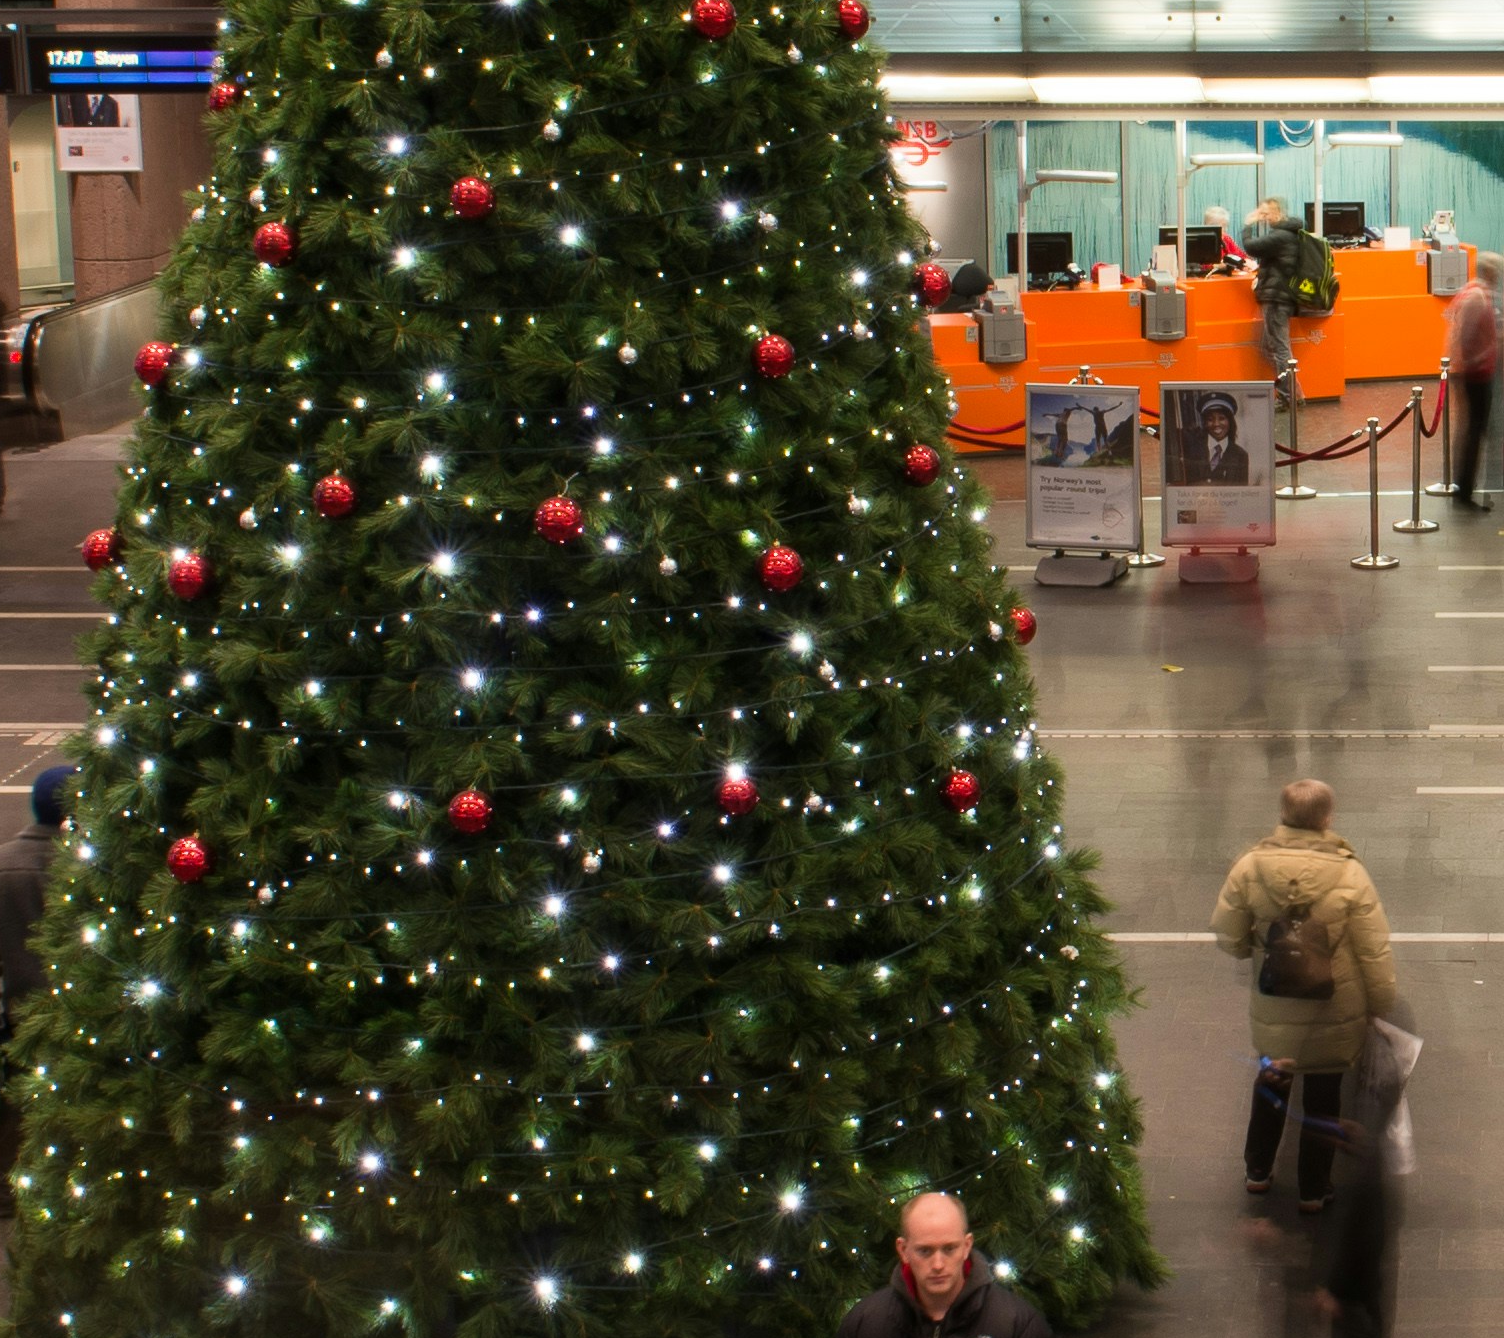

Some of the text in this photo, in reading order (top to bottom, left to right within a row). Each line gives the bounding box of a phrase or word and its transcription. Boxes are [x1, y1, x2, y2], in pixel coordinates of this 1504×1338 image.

[897, 120, 937, 138] NSB
[1053, 476, 1084, 487] Norway's
[1085, 478, 1103, 487] most
[1039, 484, 1065, 494] popular
[1066, 486, 1087, 494] round
